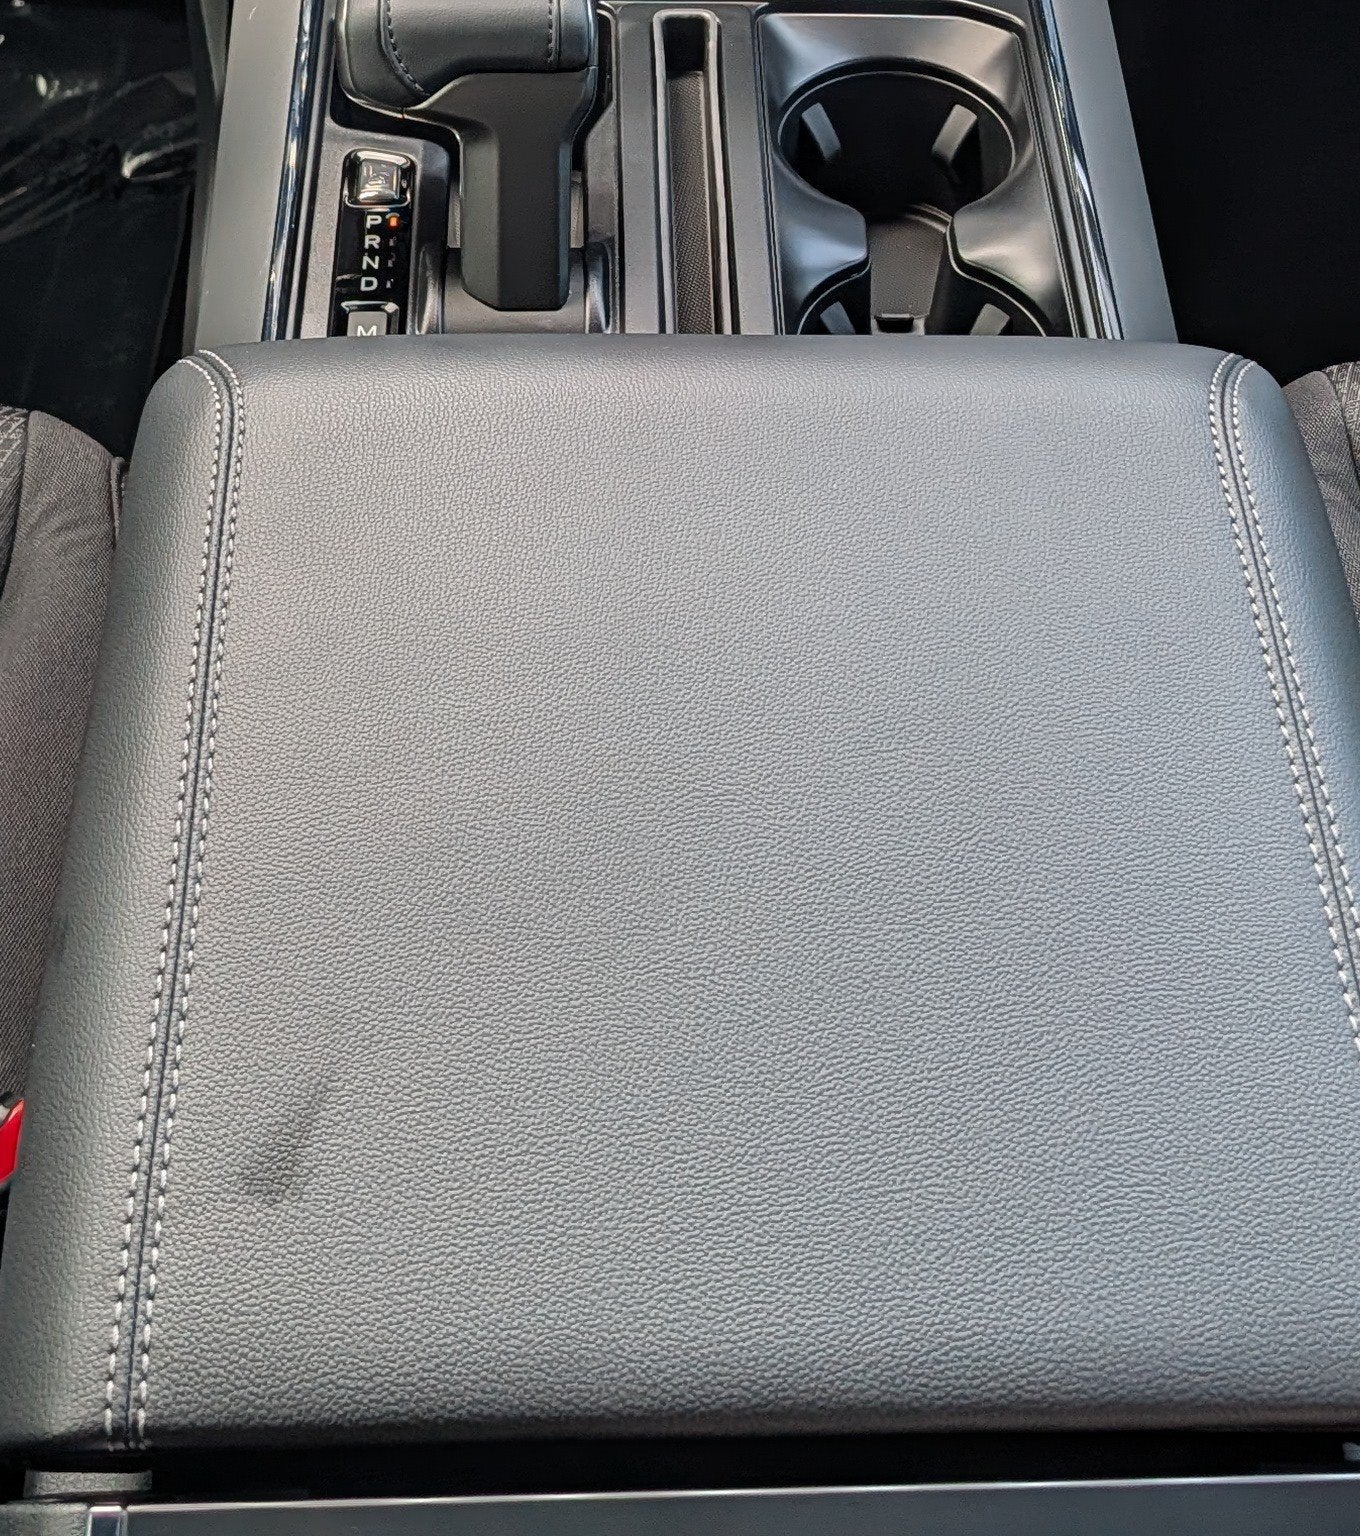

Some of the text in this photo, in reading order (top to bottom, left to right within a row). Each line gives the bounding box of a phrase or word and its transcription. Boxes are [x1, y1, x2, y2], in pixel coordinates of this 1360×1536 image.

[366, 215, 382, 230] P
[364, 234, 381, 250] R
[362, 255, 380, 270] N
[360, 276, 379, 292] D
[356, 325, 378, 336] M
